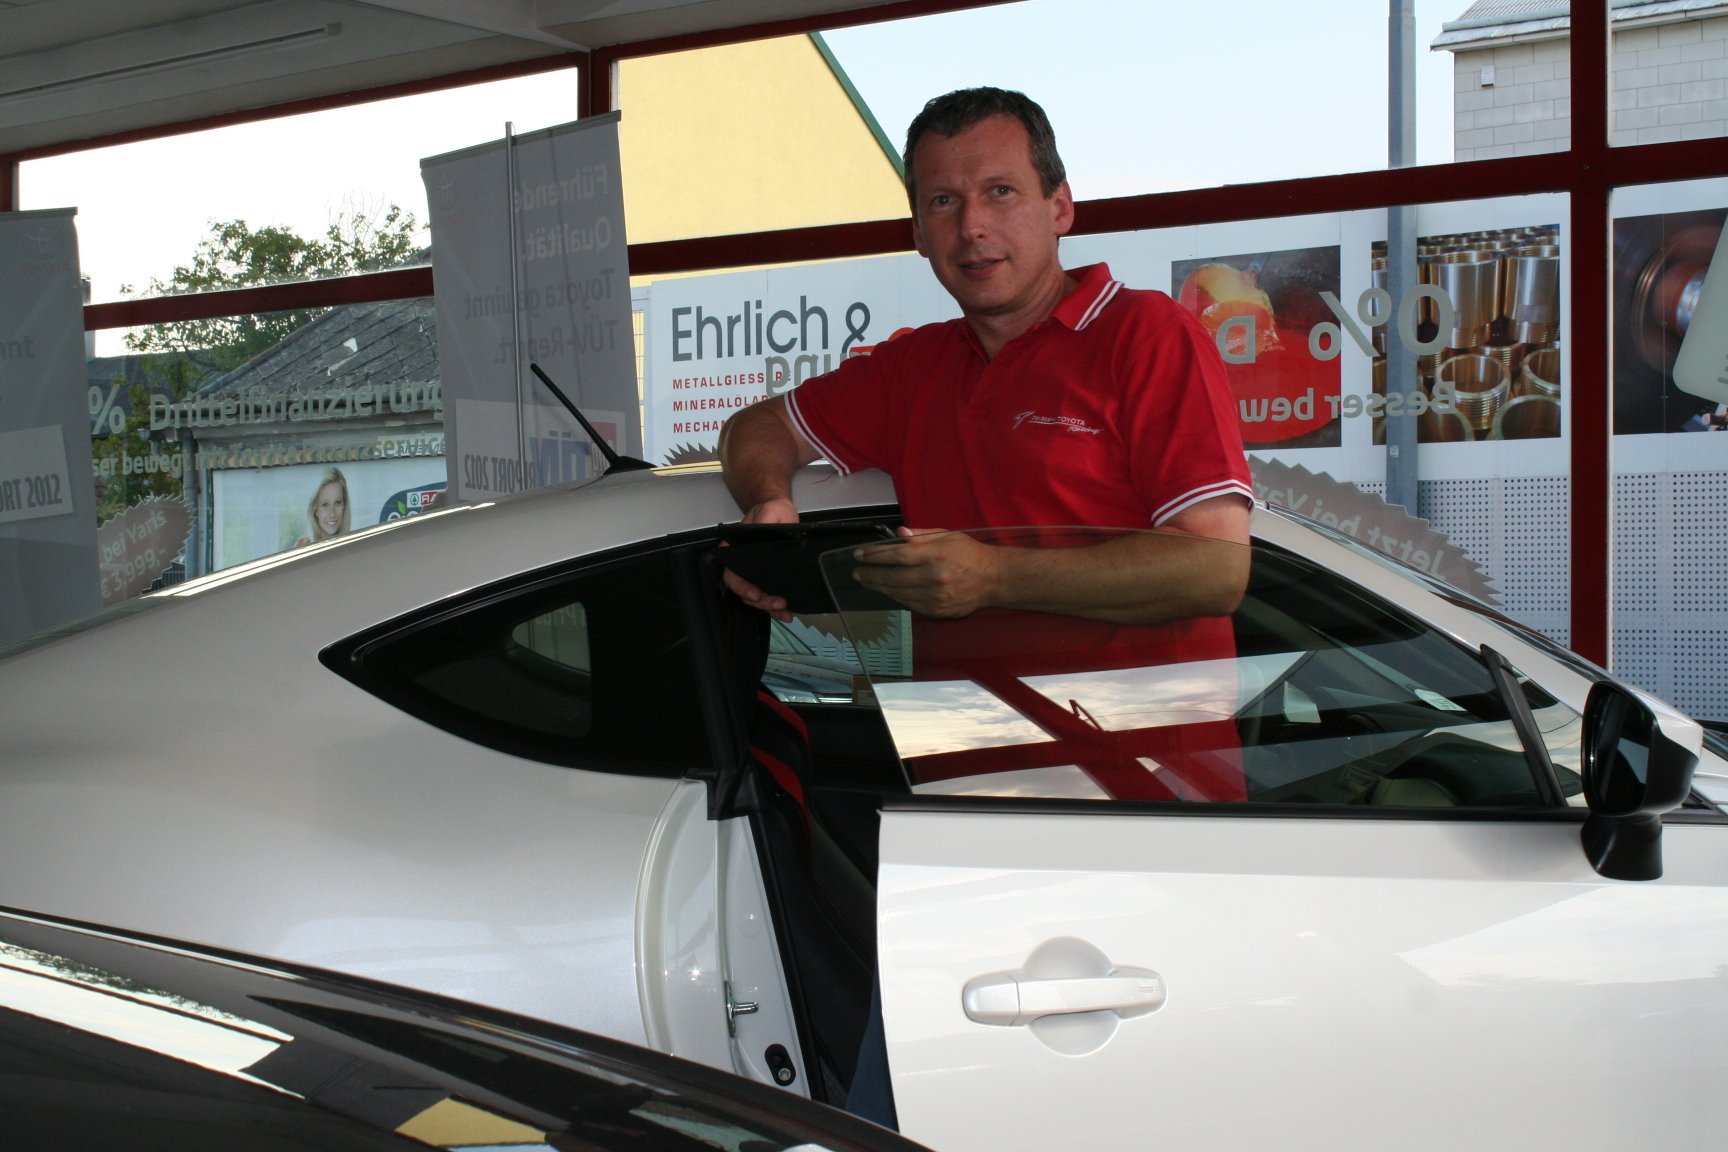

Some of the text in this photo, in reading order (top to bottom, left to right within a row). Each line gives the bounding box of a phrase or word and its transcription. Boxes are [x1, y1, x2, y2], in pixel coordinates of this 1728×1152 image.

[672, 295, 828, 362] Ehrlich
[672, 371, 791, 390] METALLGIESSR
[1058, 416, 1085, 426] TOYOTA
[25, 473, 62, 508] 2012
[103, 511, 167, 564] bei Yaris
